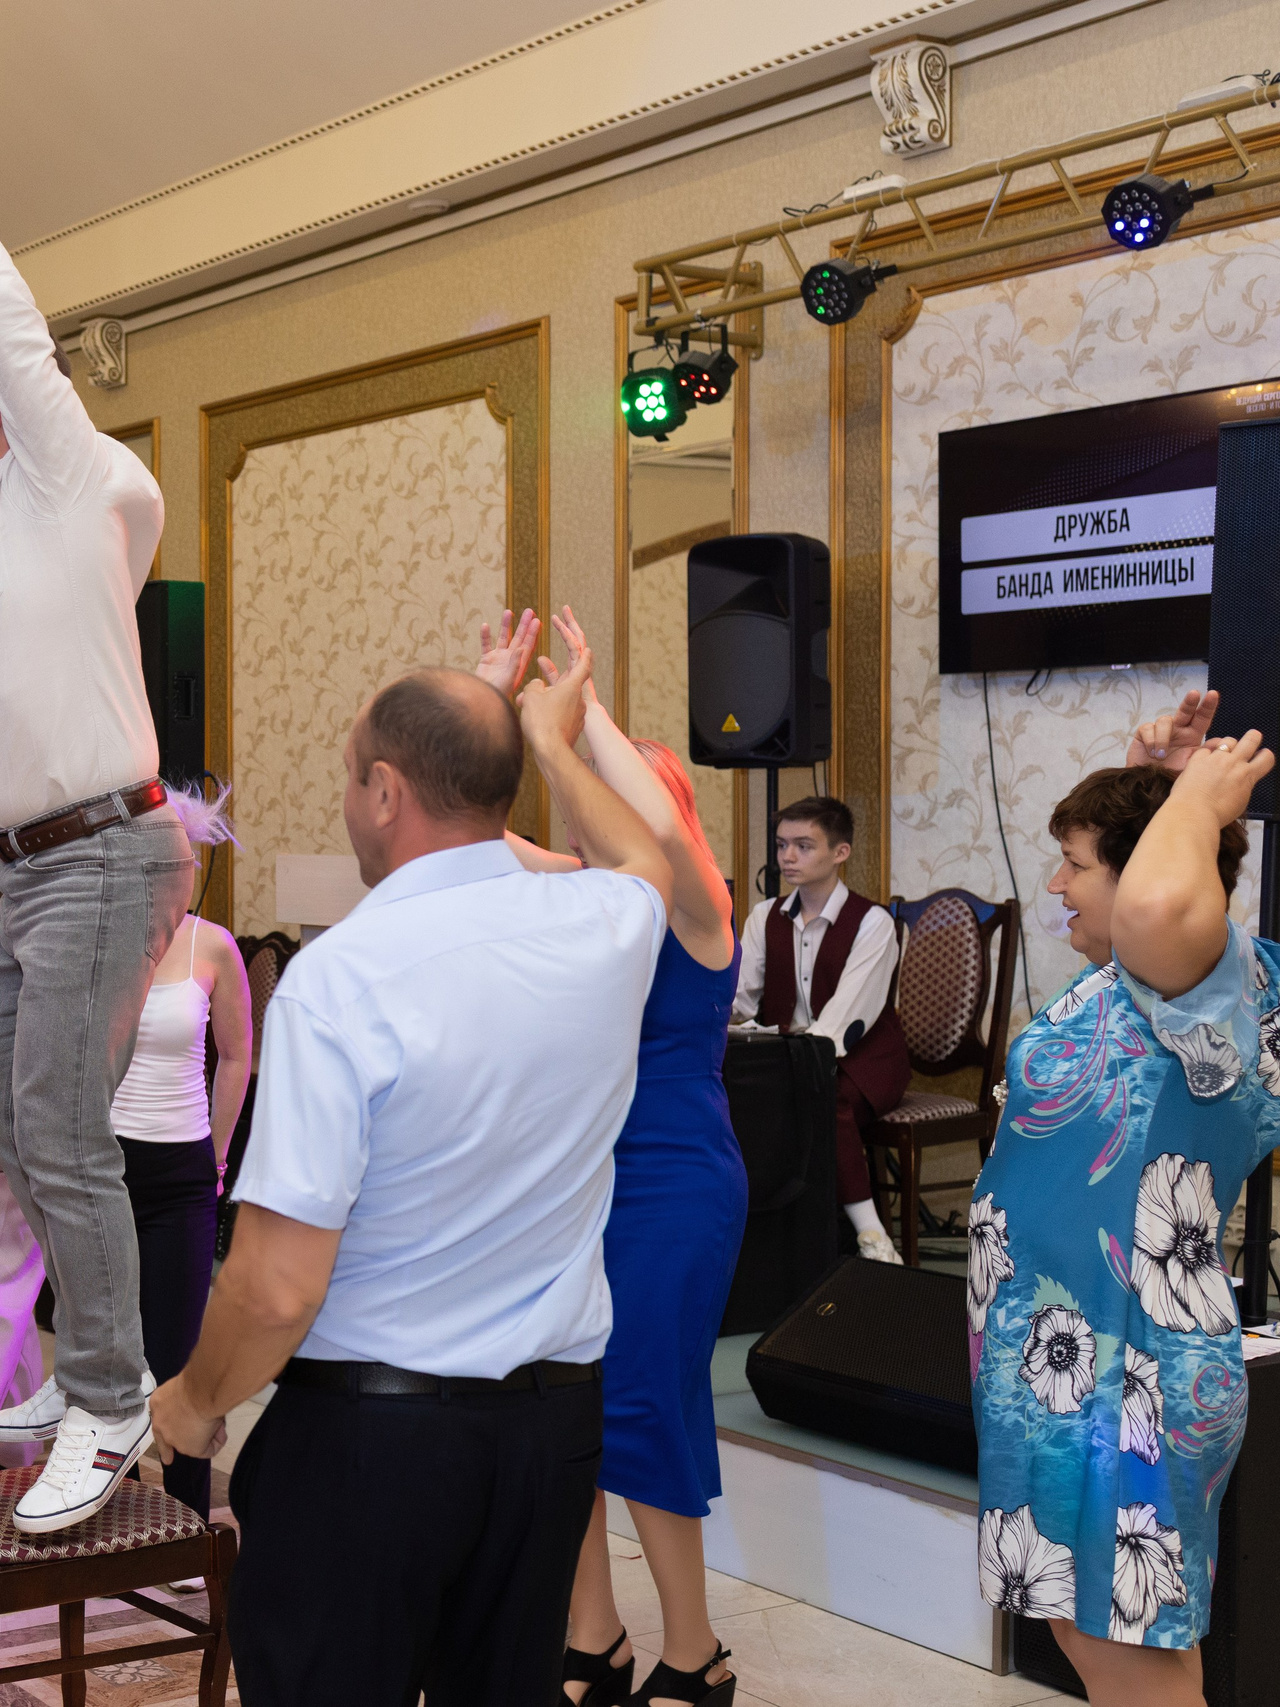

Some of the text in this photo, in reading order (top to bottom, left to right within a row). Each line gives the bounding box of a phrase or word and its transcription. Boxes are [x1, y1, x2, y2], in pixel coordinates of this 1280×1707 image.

[1054, 508, 1130, 543] ДРУЖБА
[997, 556, 1194, 599] БАНДА ИМЕНИННИЦЫ
